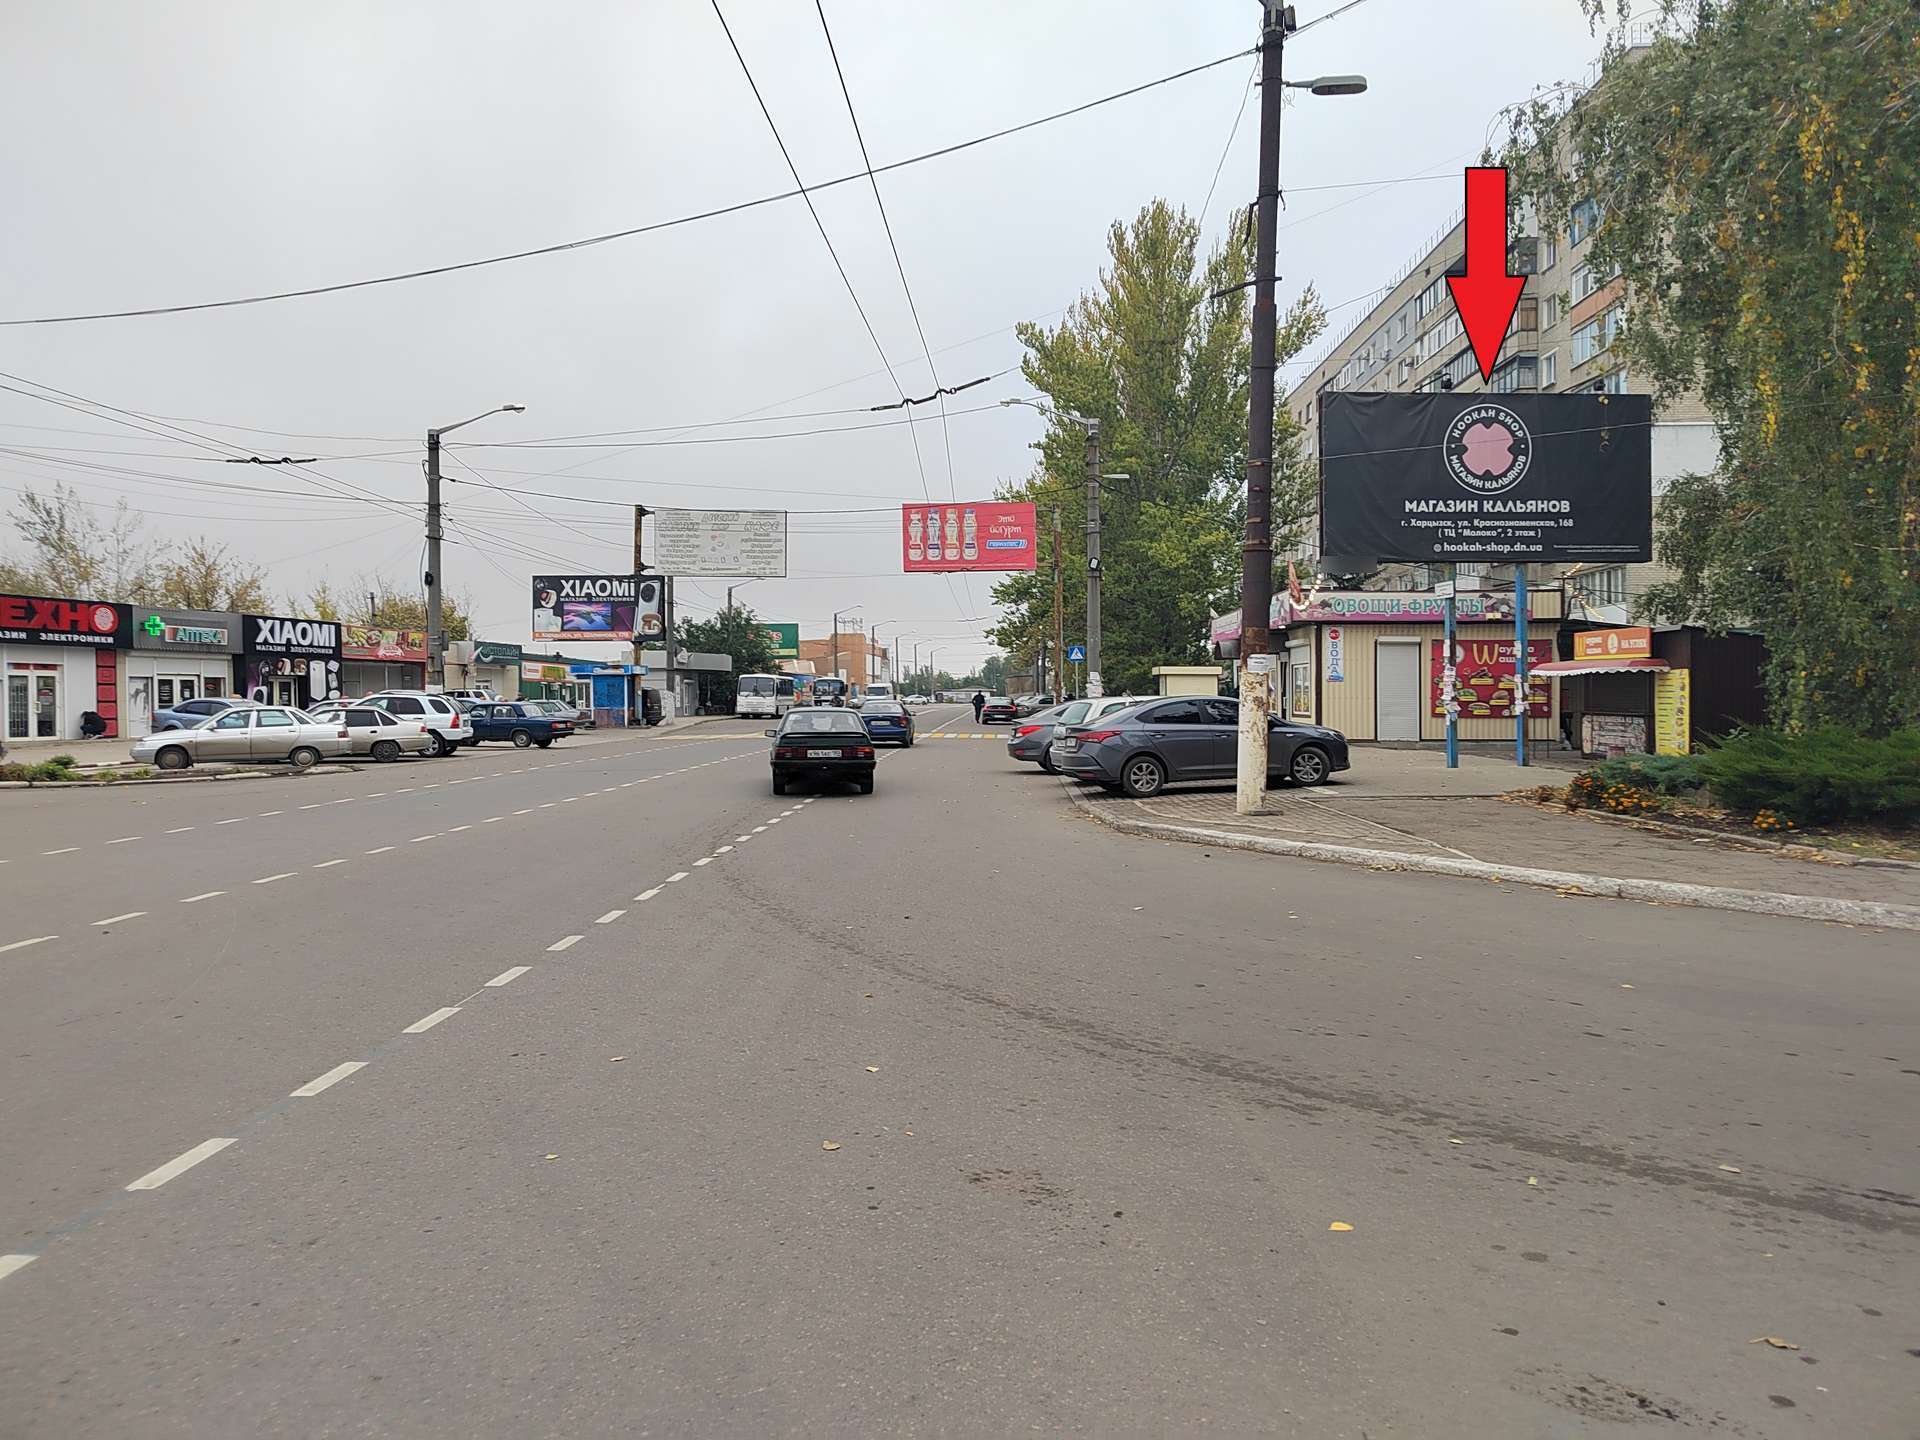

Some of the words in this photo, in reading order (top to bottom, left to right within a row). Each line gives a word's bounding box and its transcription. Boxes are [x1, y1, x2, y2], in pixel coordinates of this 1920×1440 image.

[1452, 409, 1496, 438] HOOKAH
[1498, 412, 1524, 438] SHOP
[1450, 455, 1483, 488] МАГАЗИН
[1484, 455, 1526, 489] КАЛЬЯНОВ
[1404, 500, 1478, 513] МАГАЗИН
[1484, 500, 1570, 513] КАЛЬЯНОВ
[1458, 520, 1472, 528] ул.
[1444, 530, 1456, 538] ТЦ
[1444, 542, 1542, 554] hookah-shop.dn.ua
[560, 579, 635, 597] XIAOMI
[1333, 598, 1486, 614] ОВОЩИ-ФРУТЫ
[40, 632, 114, 644] ЭЛЕКТРОНИКИ
[176, 627, 224, 642] АПТЕКА
[256, 618, 336, 647] XIAOMI
[290, 646, 334, 654] ЭЛЕКТРОНИКИ
[1330, 642, 1338, 674] ВОДА
